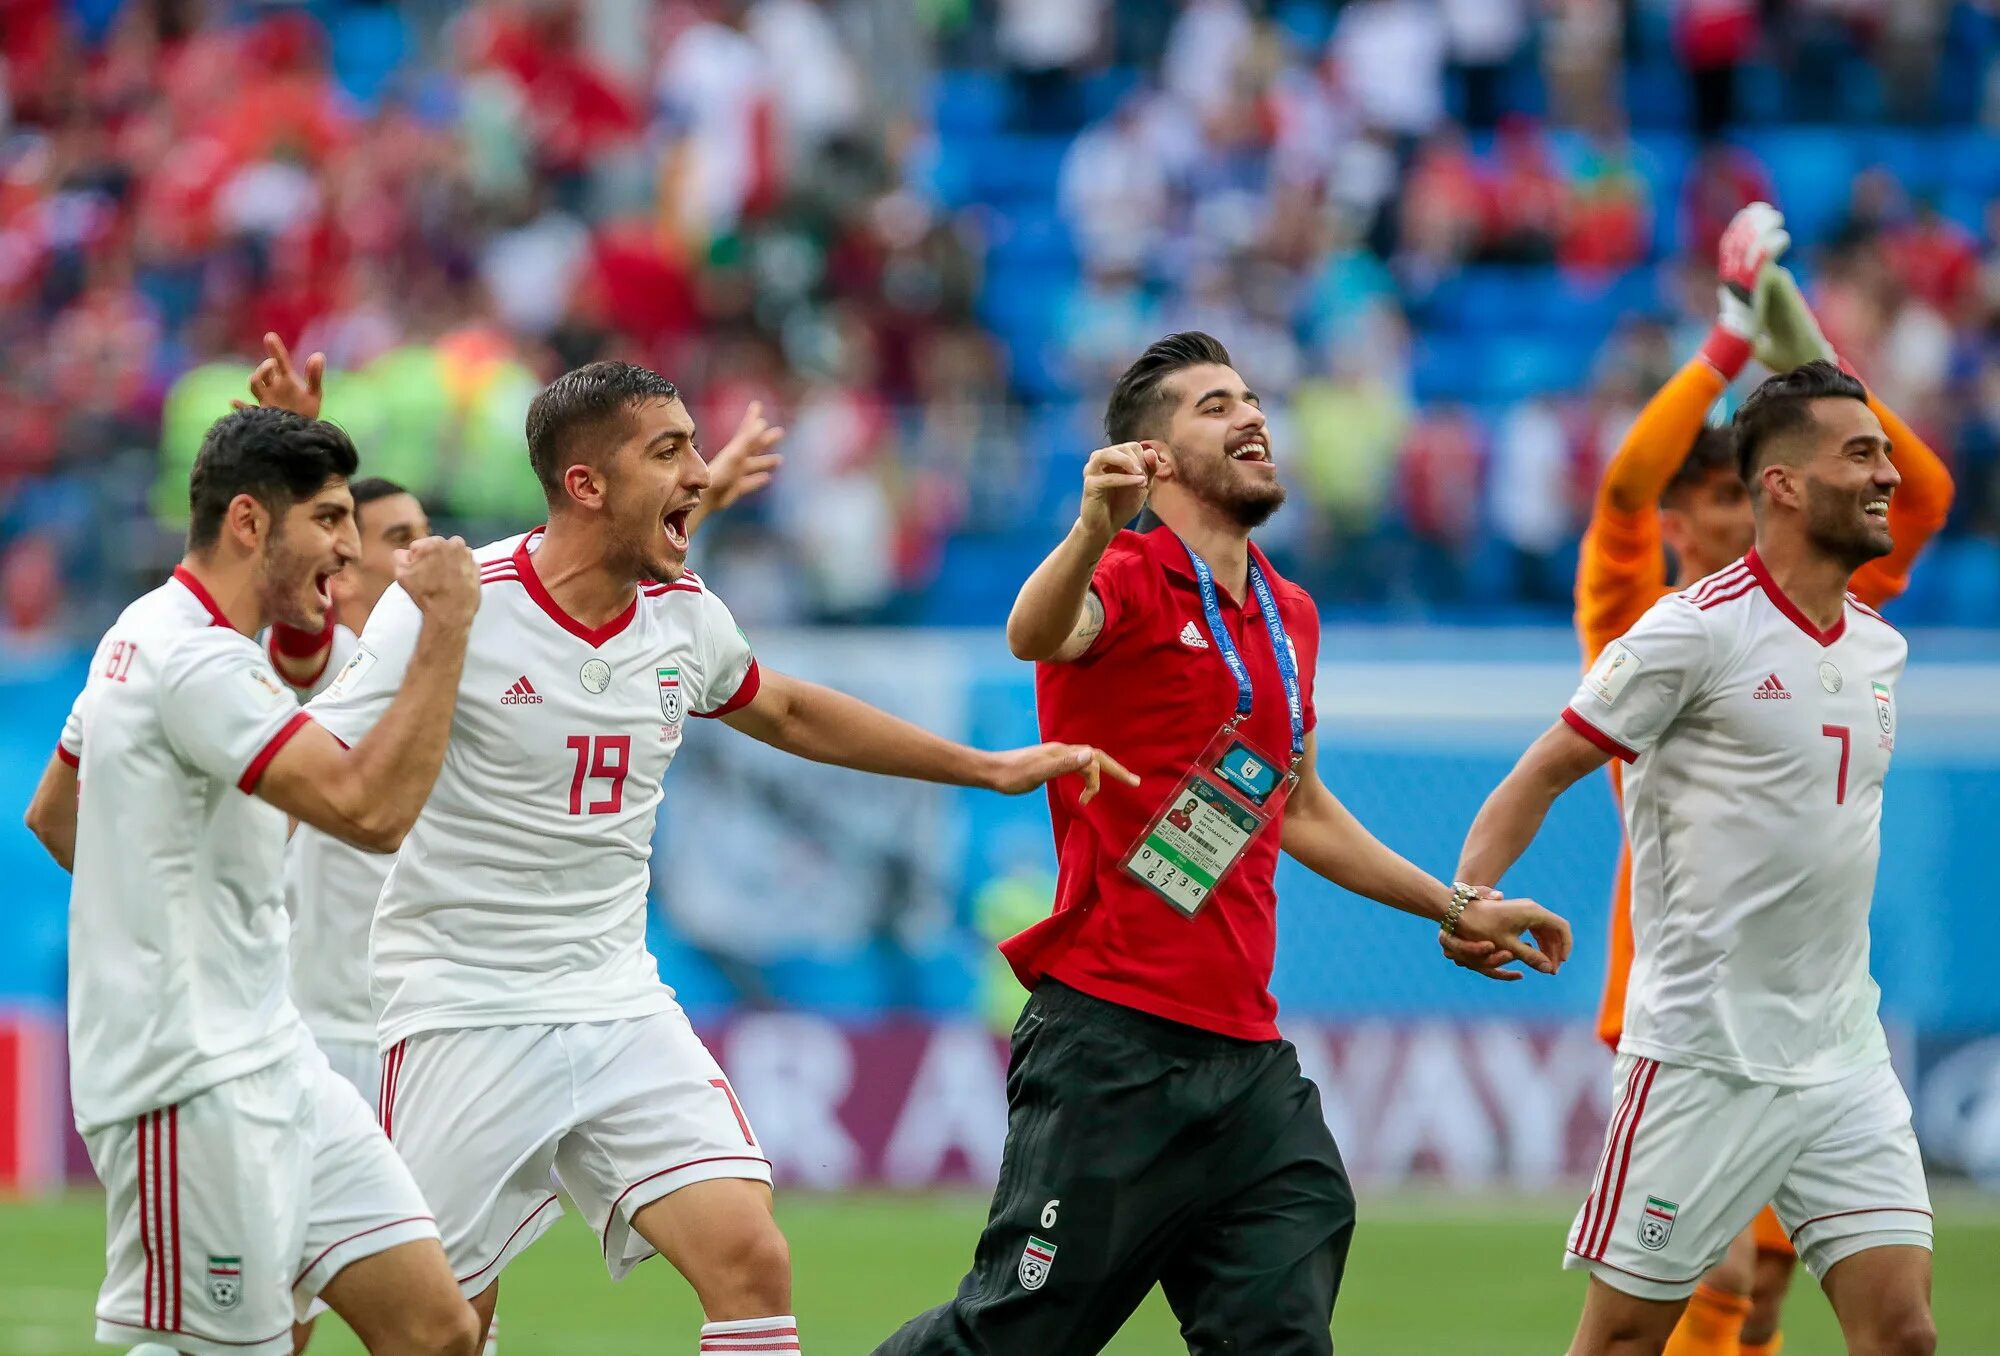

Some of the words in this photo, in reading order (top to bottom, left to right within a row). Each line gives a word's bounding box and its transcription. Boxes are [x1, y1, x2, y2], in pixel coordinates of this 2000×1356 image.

[1200, 571, 1215, 611] RUSSIA
[1255, 579, 1272, 606] WORLD
[1265, 605, 1278, 622] FIFA
[1179, 634, 1210, 649] adidas
[1270, 622, 1283, 642] 2018
[500, 693, 543, 705] adidas
[1752, 689, 1792, 700] adidas
[1246, 766, 1254, 776] 4
[1822, 723, 1850, 805] 7
[566, 735, 631, 815] 19
[1142, 849, 1151, 859] 0
[1156, 859, 1163, 868] 1
[1167, 868, 1176, 878] 2
[1179, 877, 1189, 887] 3
[1192, 887, 1201, 896] 4
[1147, 870, 1156, 879] 6
[1160, 878, 1169, 887] 7
[1041, 1200, 1060, 1229] 6
